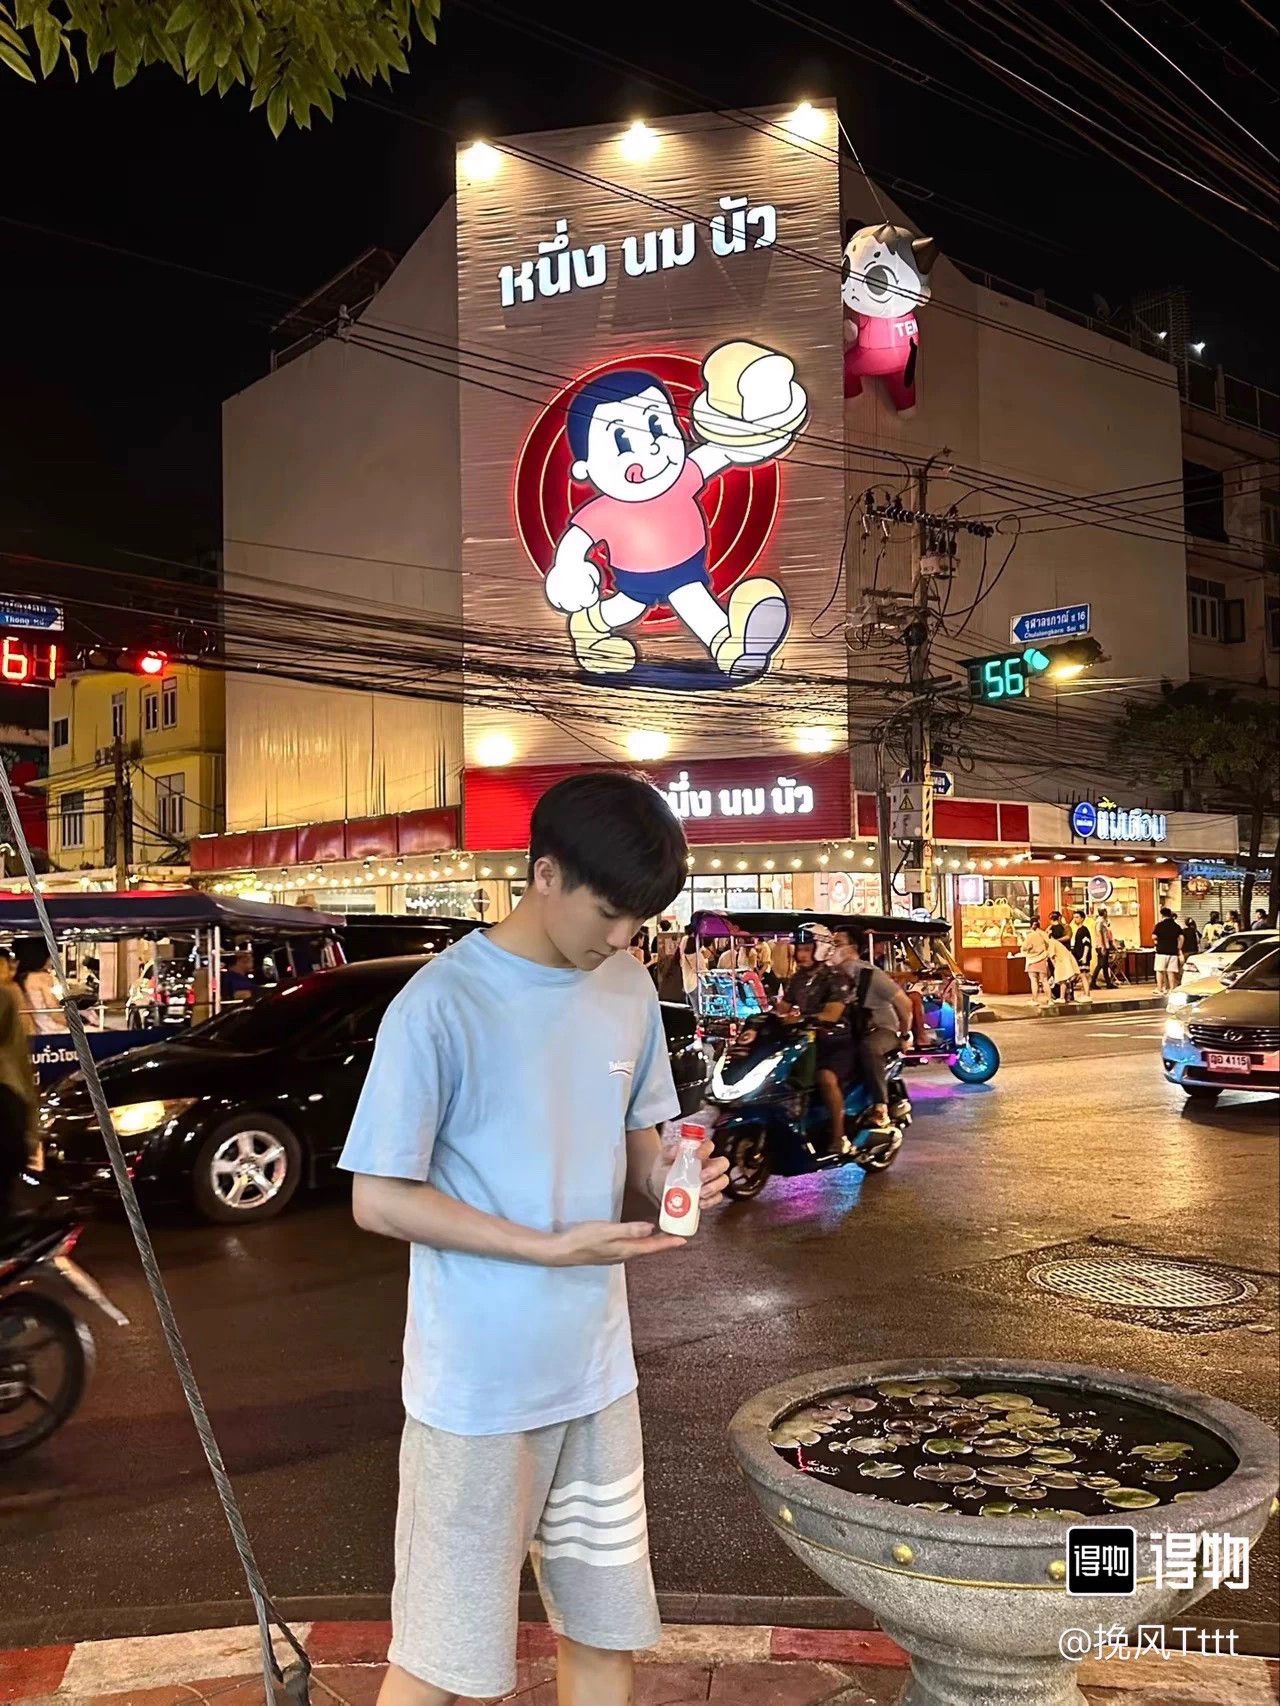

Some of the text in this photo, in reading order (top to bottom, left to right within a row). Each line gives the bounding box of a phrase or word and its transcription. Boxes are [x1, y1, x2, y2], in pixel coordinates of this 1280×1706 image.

[498, 195, 778, 308] หนึ่ง นม นัว
[5, 615, 30, 627] Thong
[2, 636, 57, 680] 61
[985, 657, 1024, 698] 56
[660, 771, 814, 818] นึ่ง นม นัว
[1226, 1056, 1247, 1066] 4115
